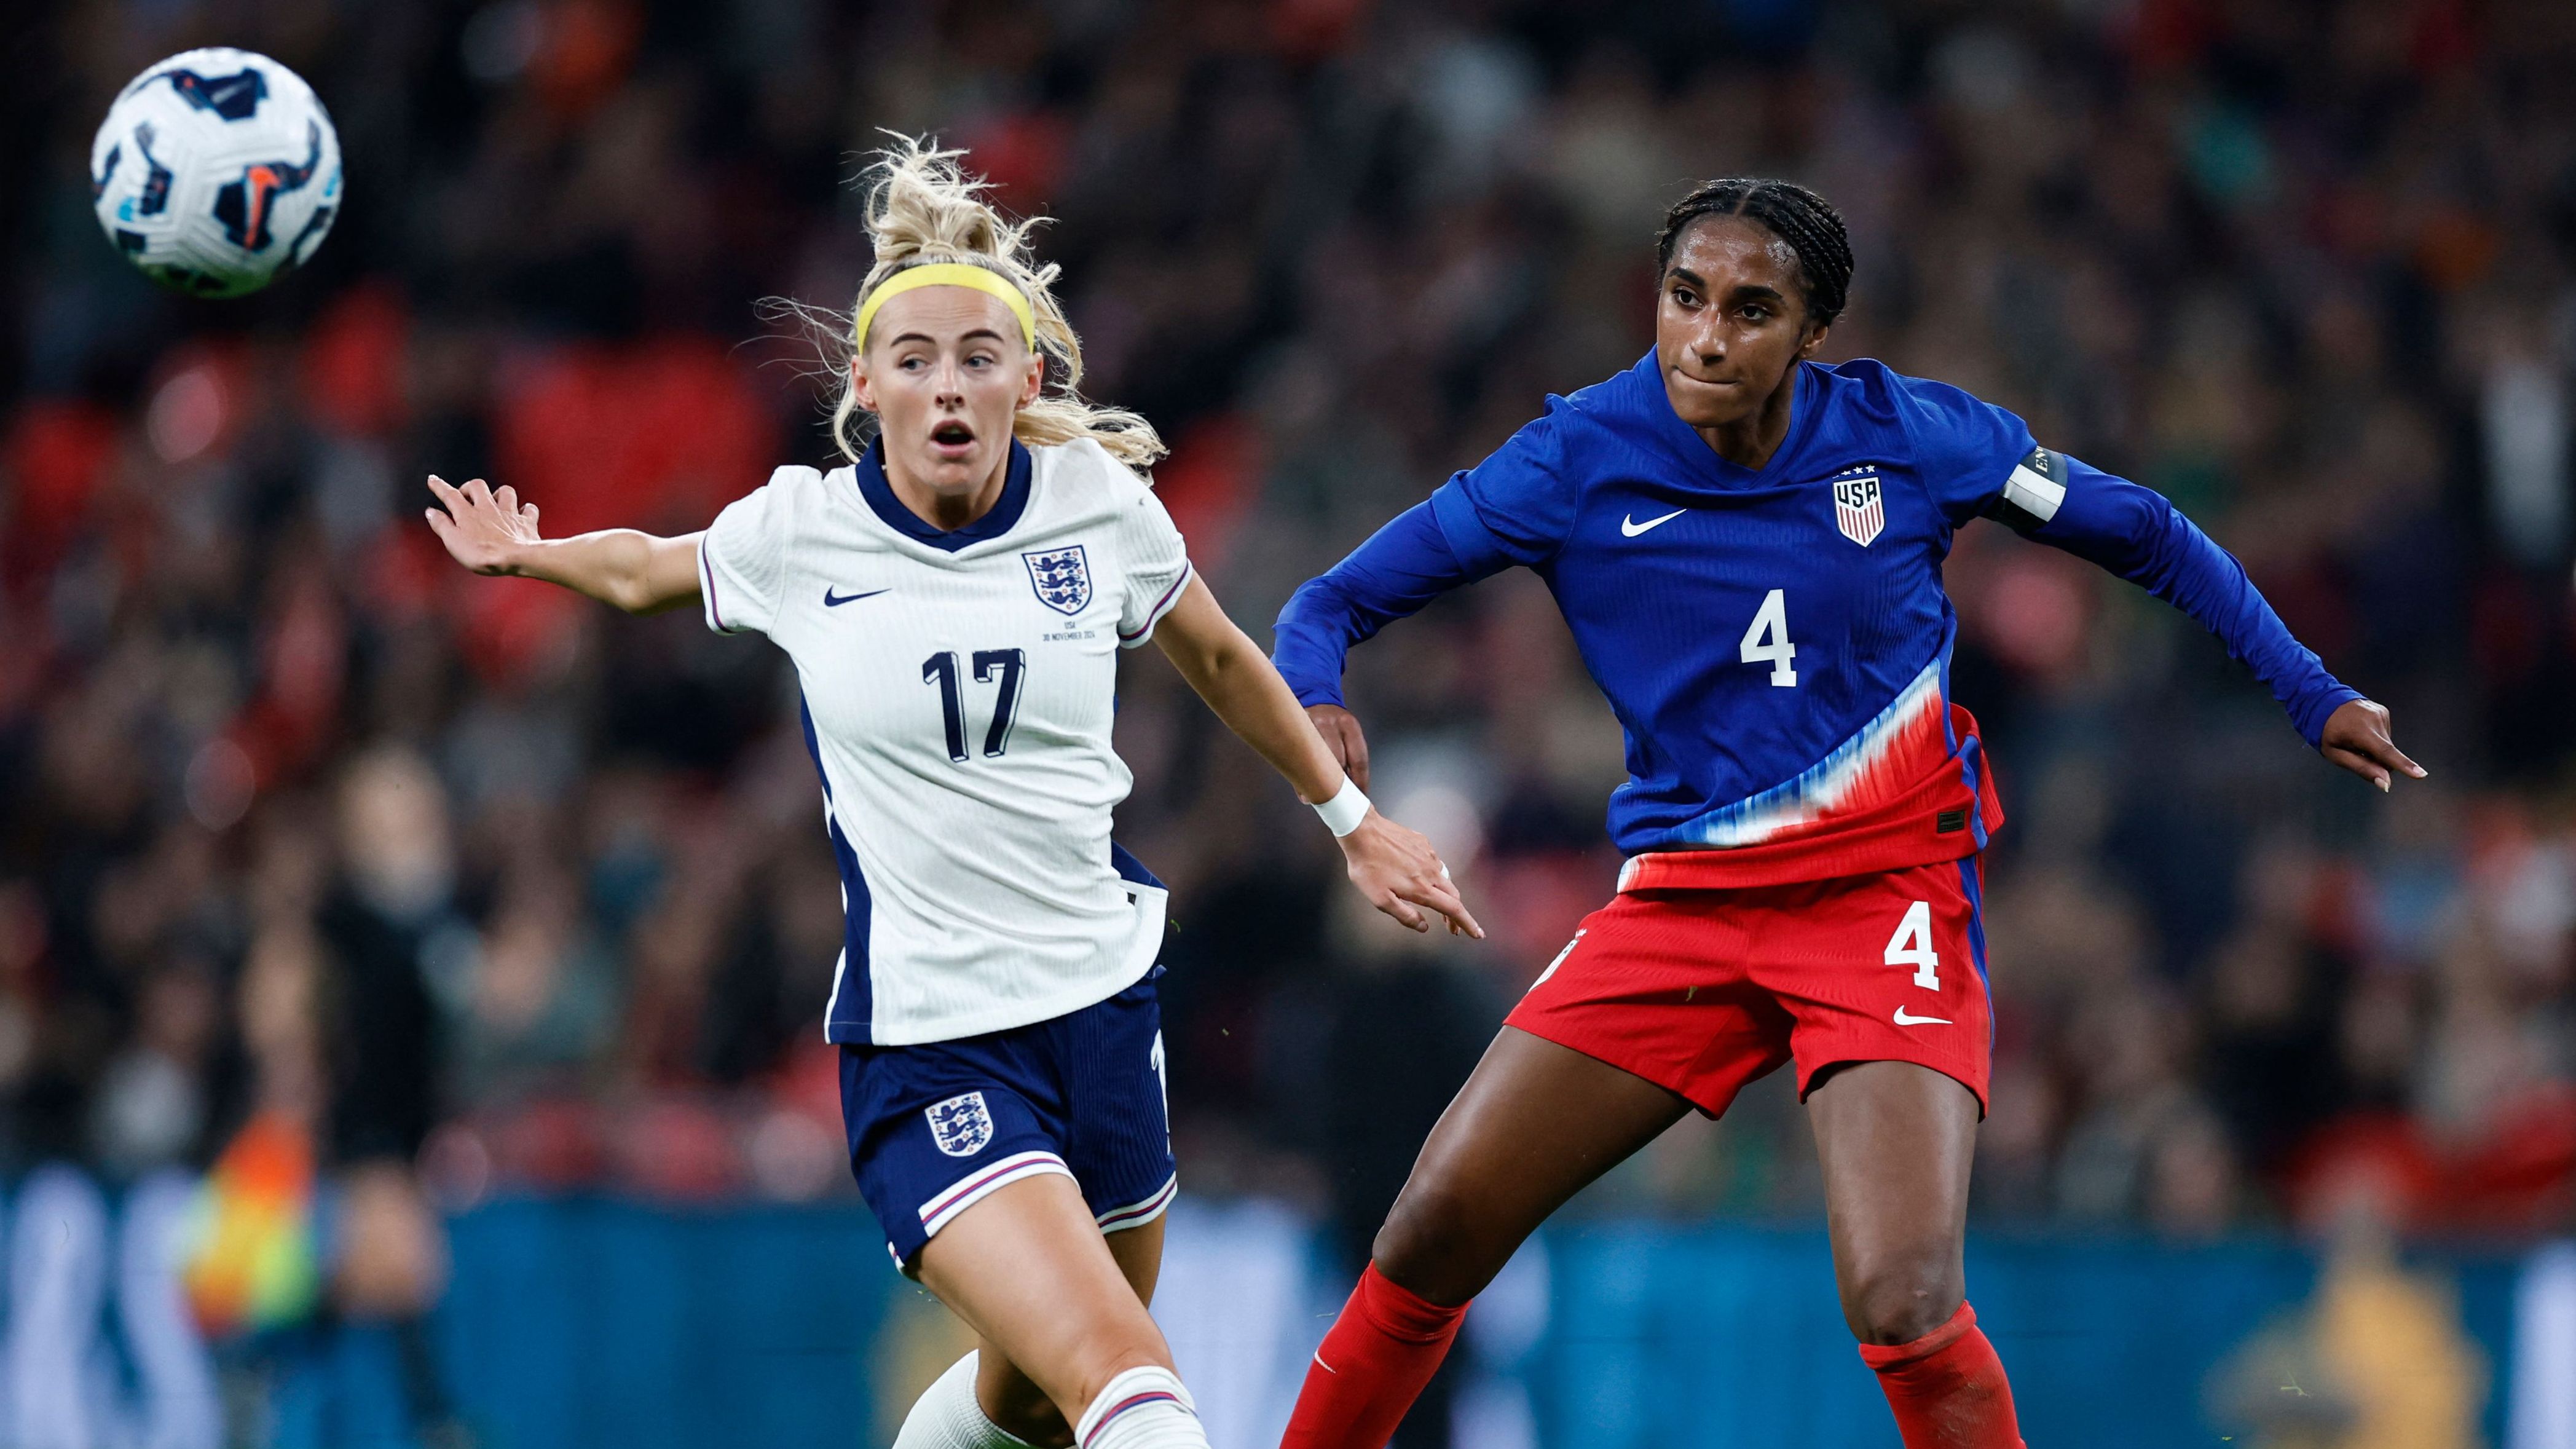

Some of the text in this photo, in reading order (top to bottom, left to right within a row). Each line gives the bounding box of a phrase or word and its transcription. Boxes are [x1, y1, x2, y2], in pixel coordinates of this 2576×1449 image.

[1837, 481, 1878, 508] USA
[1052, 631, 1082, 641] NOVEMBER
[1084, 630, 1095, 639] 2024
[1064, 621, 1076, 630] USA
[1739, 588, 1797, 687] 4
[922, 647, 1026, 763] 17
[1883, 900, 1940, 992] 4
